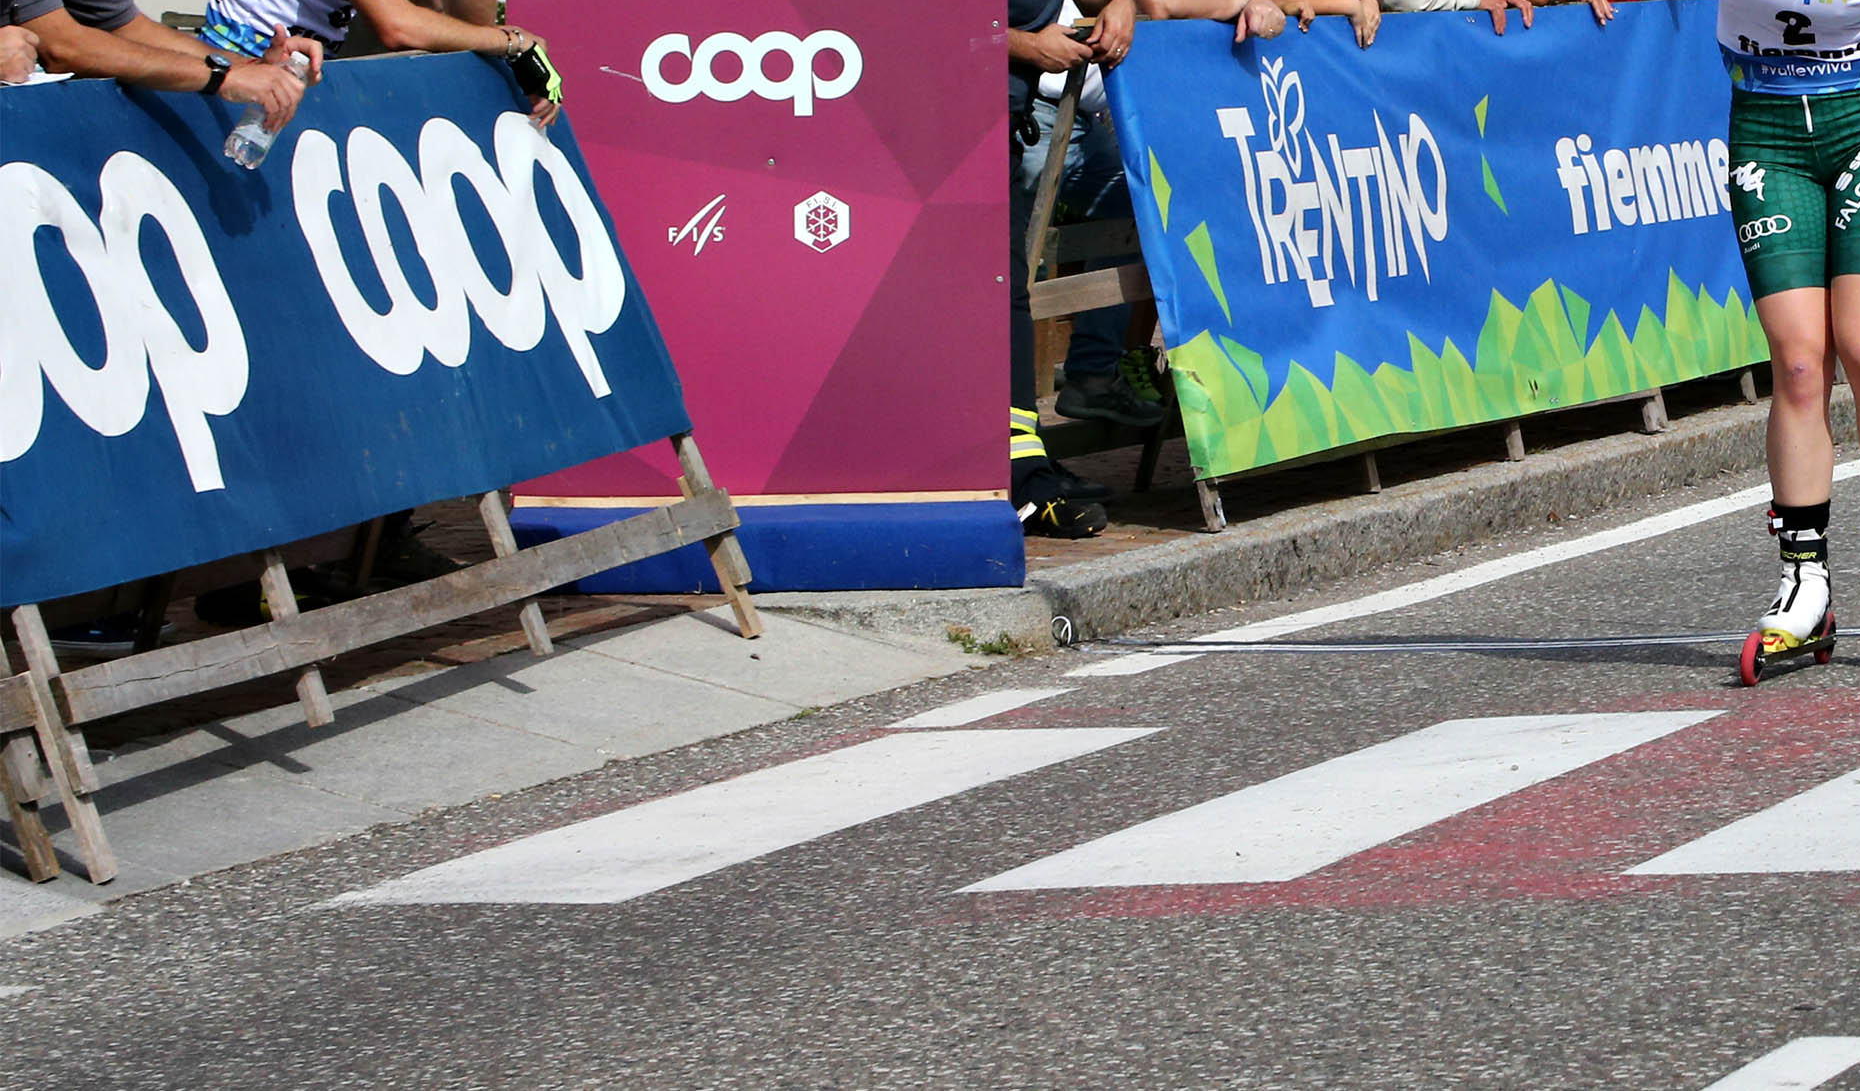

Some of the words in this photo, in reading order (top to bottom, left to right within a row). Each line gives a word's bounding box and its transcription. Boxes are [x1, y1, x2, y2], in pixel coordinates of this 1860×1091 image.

[640, 30, 864, 117] coop
[1775, 11, 1816, 46] 2
[1216, 106, 1448, 308] TRENTINO
[1555, 133, 1732, 235] fiemme
[292, 111, 626, 399] coop
[1744, 243, 1761, 254] Audi
